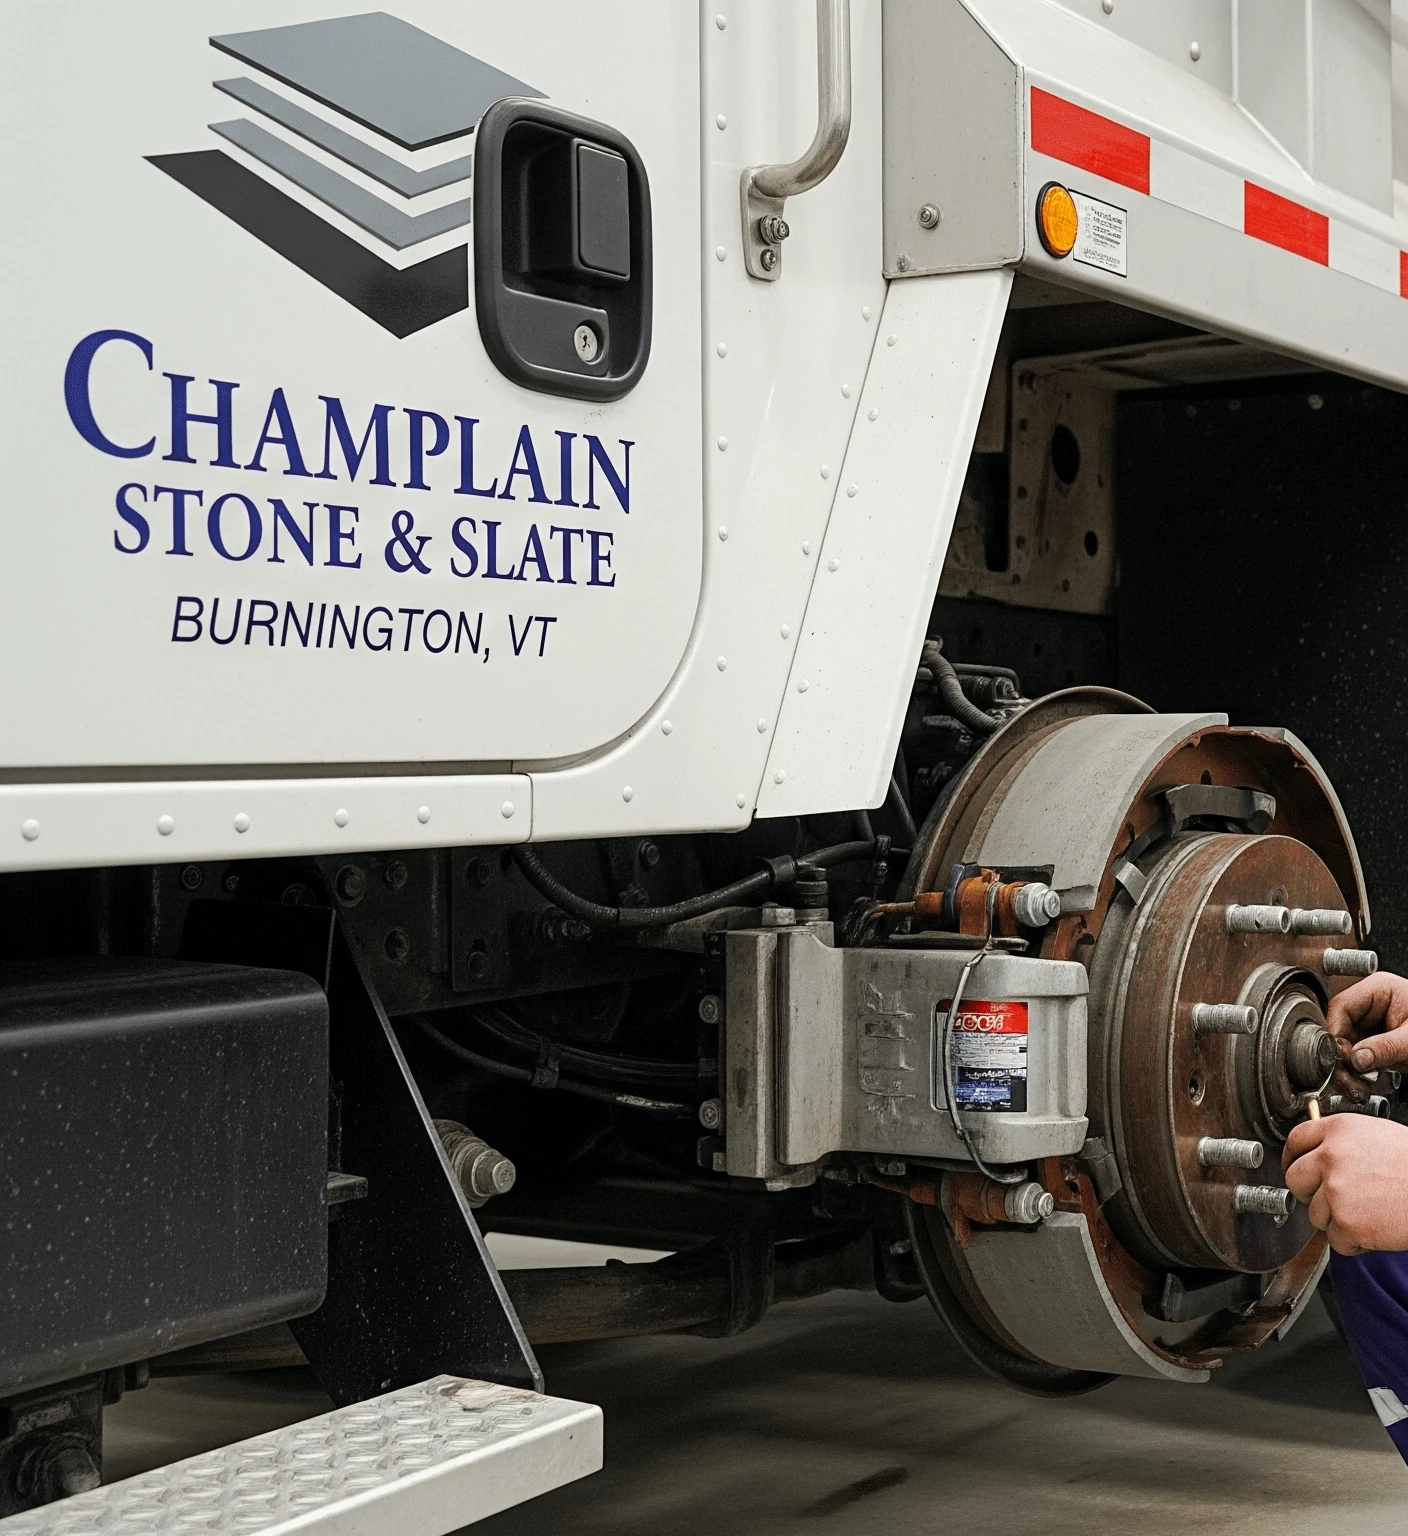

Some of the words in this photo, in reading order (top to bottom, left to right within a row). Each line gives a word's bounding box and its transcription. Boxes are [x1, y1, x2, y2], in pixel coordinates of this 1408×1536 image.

[63, 329, 636, 515] CHAMPLAIN
[113, 482, 363, 570] STONE
[384, 509, 433, 575] &
[450, 516, 617, 588] SLATE
[171, 595, 490, 664] BURNINGTON,
[508, 614, 558, 657] VT
